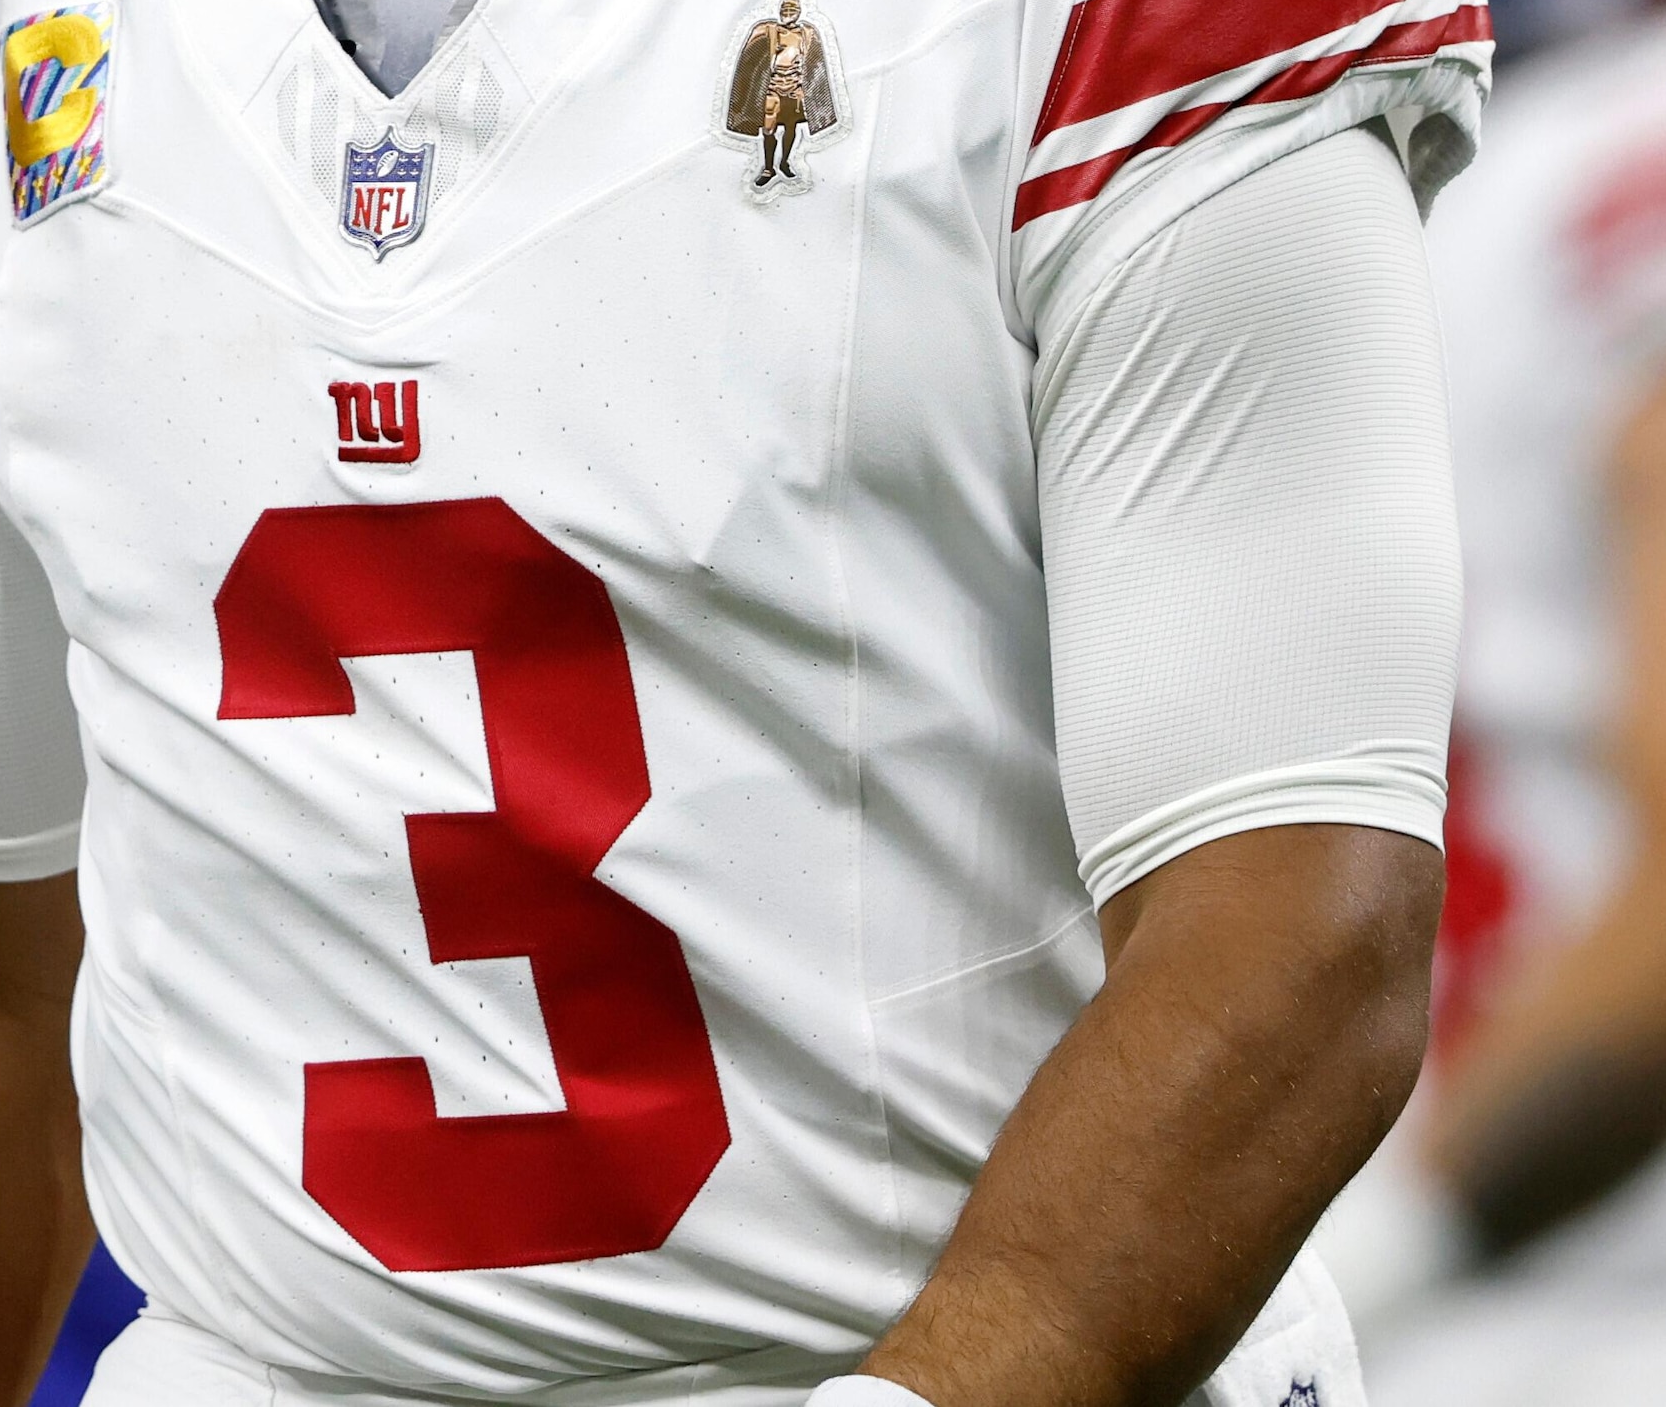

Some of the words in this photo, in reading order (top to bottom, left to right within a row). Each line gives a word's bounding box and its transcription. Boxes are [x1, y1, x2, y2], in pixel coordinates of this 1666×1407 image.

[5, 13, 102, 169] C
[351, 186, 409, 235] NFL
[213, 496, 732, 1273] 3
